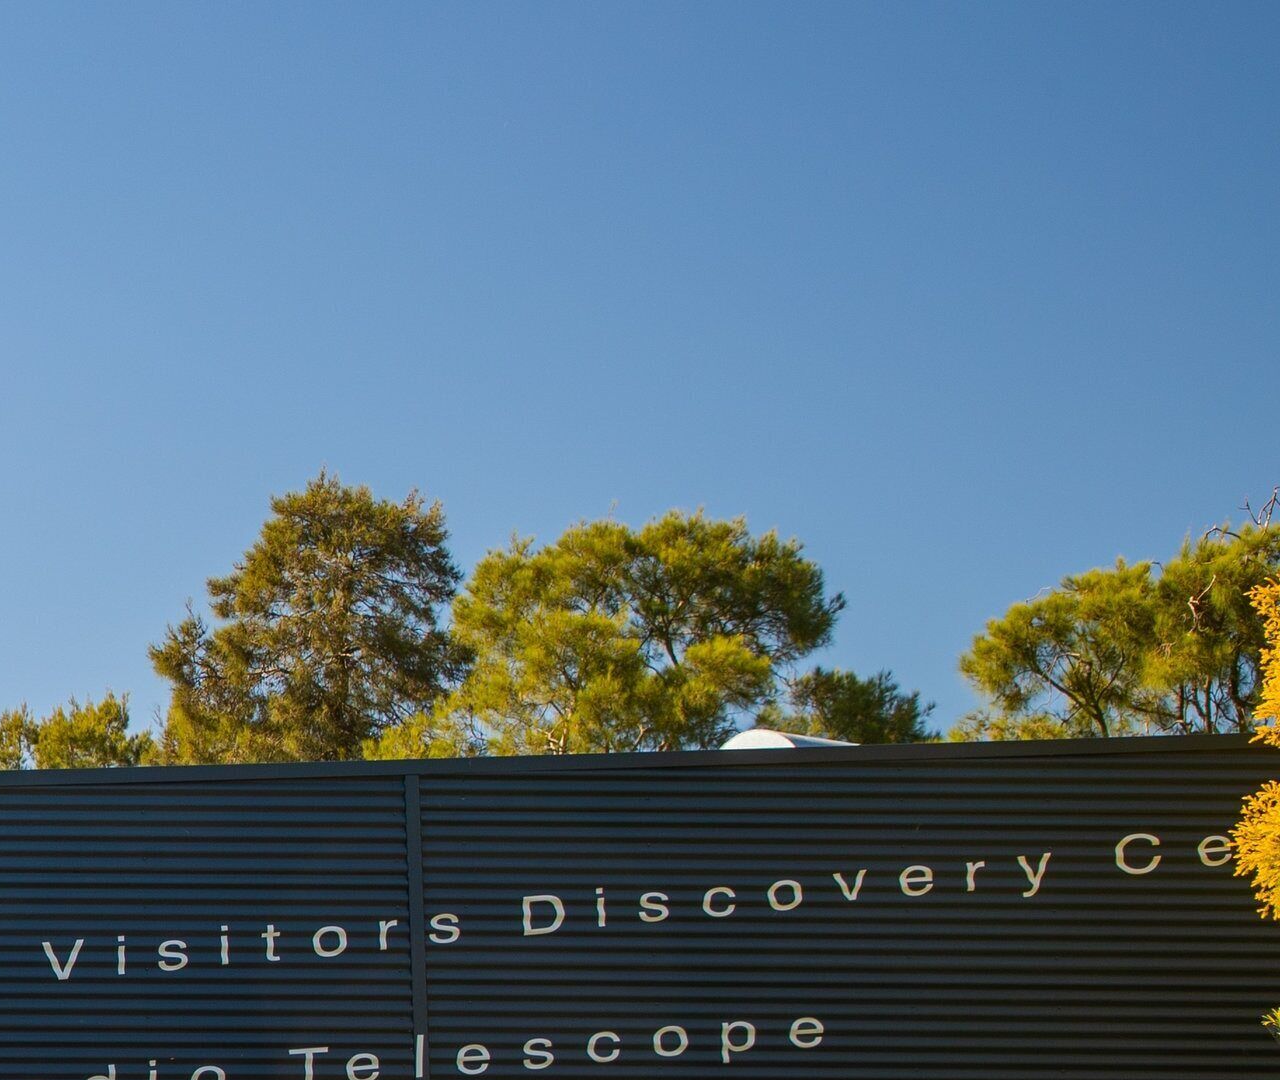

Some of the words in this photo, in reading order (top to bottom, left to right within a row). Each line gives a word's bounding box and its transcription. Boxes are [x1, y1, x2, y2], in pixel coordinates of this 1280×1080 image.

[41, 911, 462, 981] Visitors
[521, 851, 1053, 936] Discovery
[1114, 832, 1233, 875] Ce
